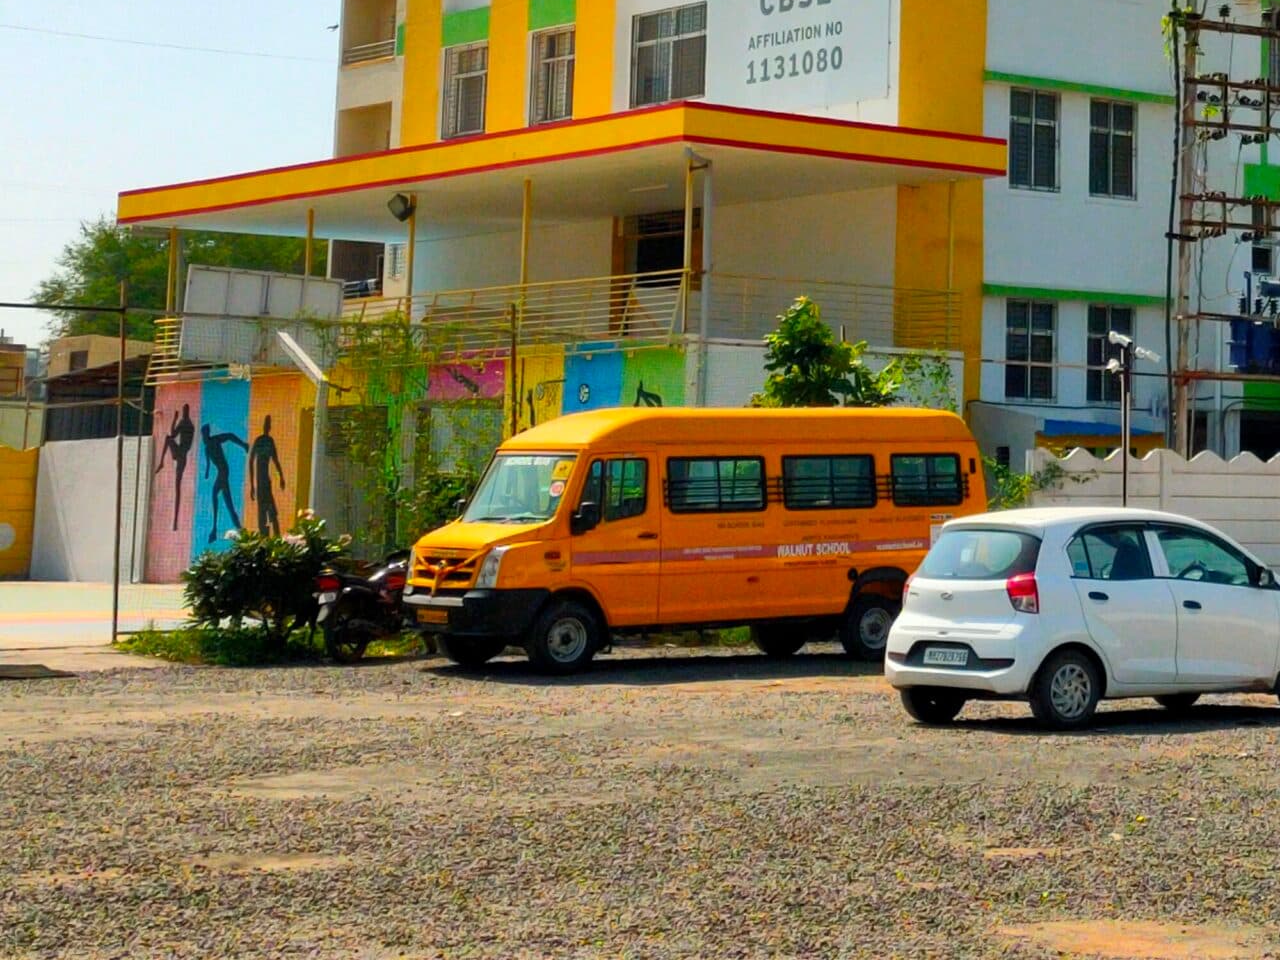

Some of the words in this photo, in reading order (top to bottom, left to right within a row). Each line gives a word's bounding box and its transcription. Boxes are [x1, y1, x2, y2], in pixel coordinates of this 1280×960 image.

[747, 24, 822, 51] AFFILIATION
[825, 20, 843, 37] NO
[745, 45, 843, 85] 1131080
[776, 543, 814, 558] WALNUT
[816, 541, 851, 556] SCHOOL
